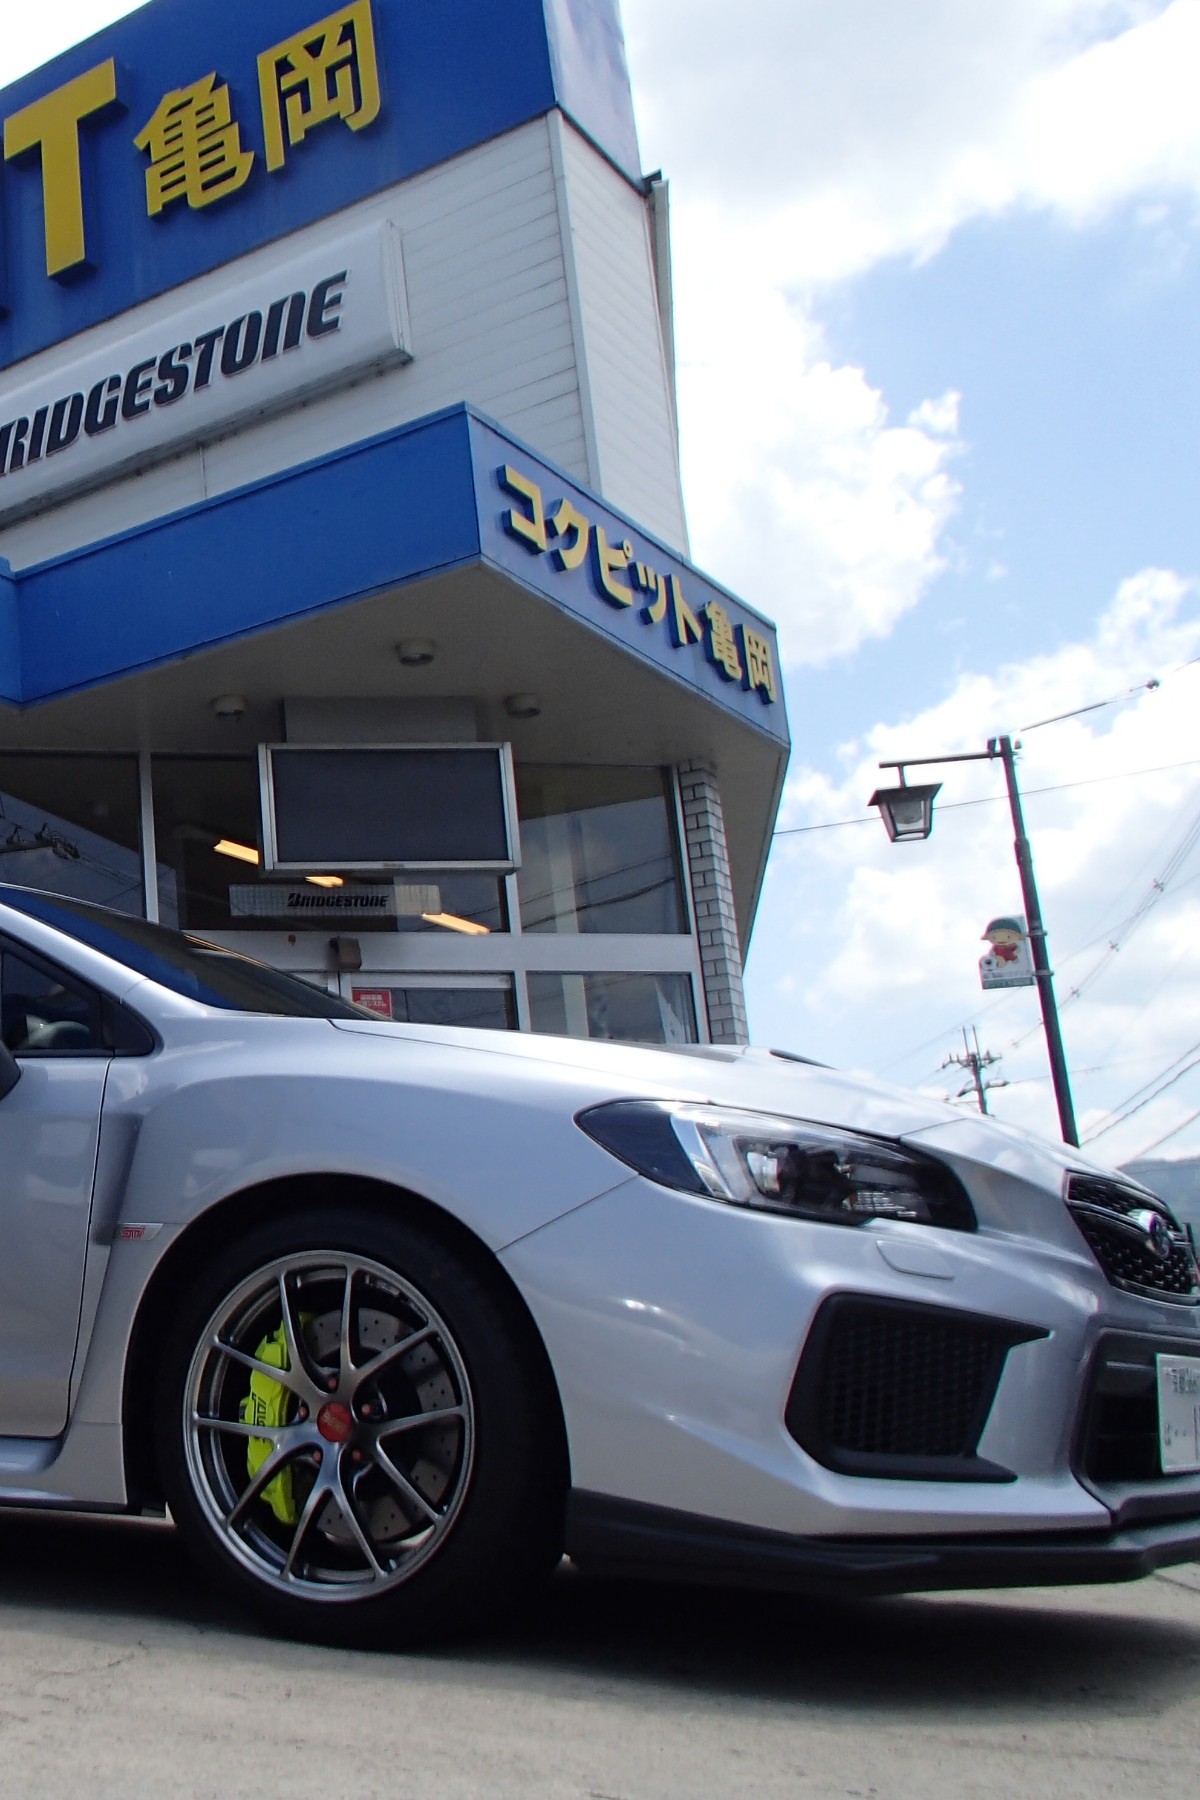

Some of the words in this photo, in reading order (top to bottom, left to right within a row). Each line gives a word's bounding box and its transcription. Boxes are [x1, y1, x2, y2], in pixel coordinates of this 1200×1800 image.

[134, 0, 382, 217] 亀岡
[497, 464, 776, 705] コクピット亀岡
[287, 892, 389, 907] BRIDGESTONE
